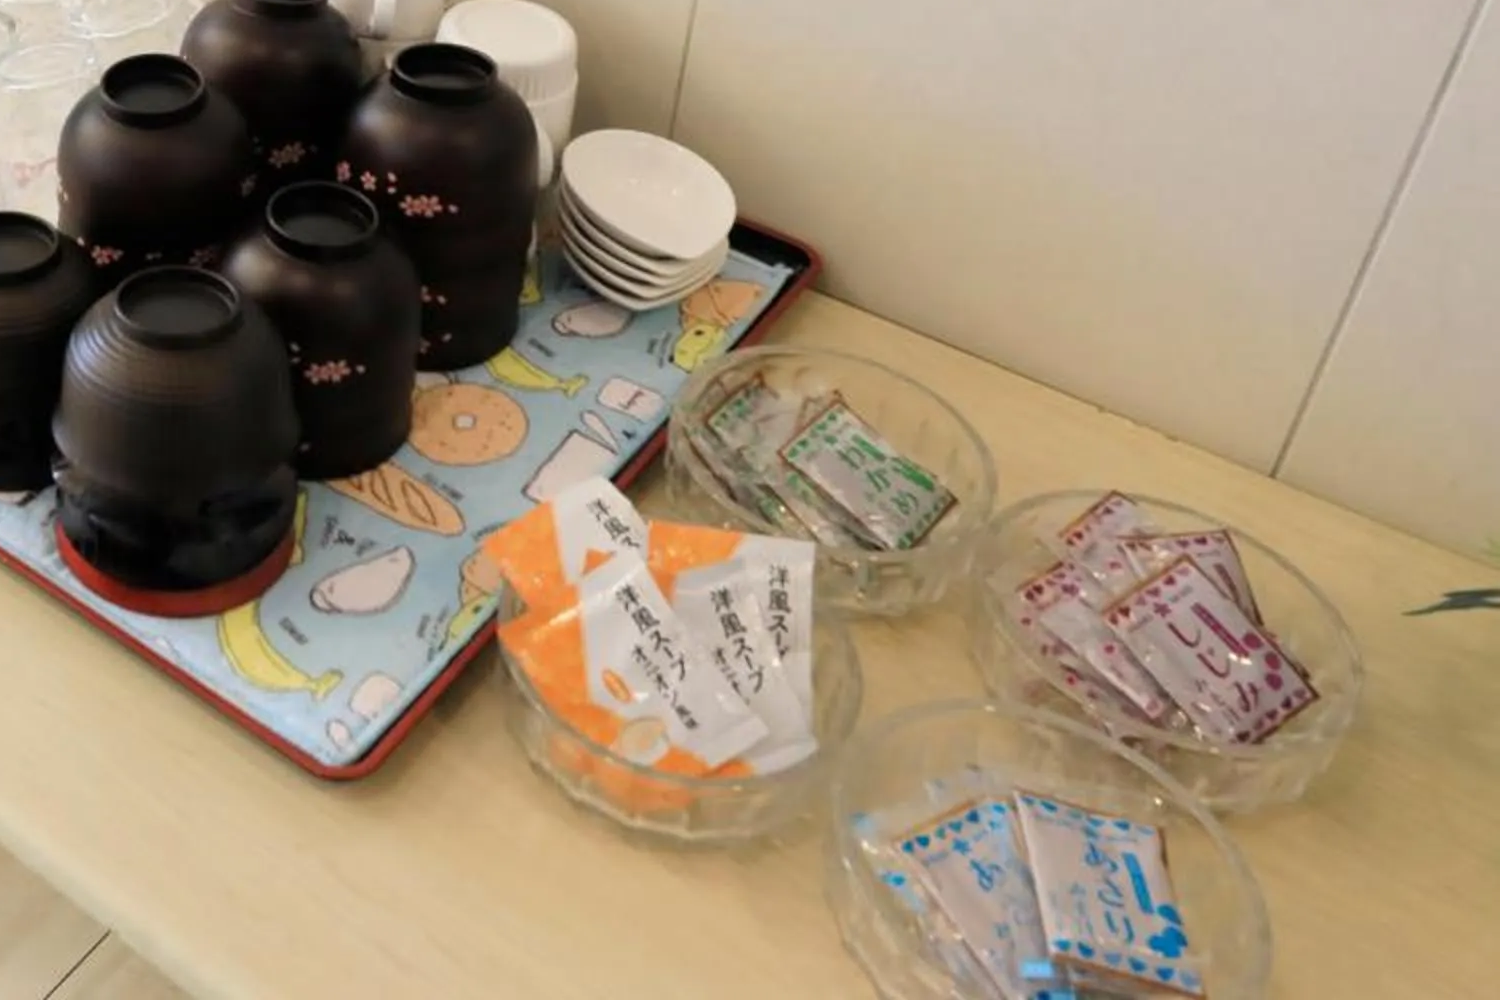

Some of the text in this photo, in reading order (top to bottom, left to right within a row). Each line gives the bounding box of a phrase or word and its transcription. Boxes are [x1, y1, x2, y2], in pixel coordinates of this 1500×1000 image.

[614, 583, 686, 681] 洋風スープ
[710, 584, 765, 695] 洋風スープ
